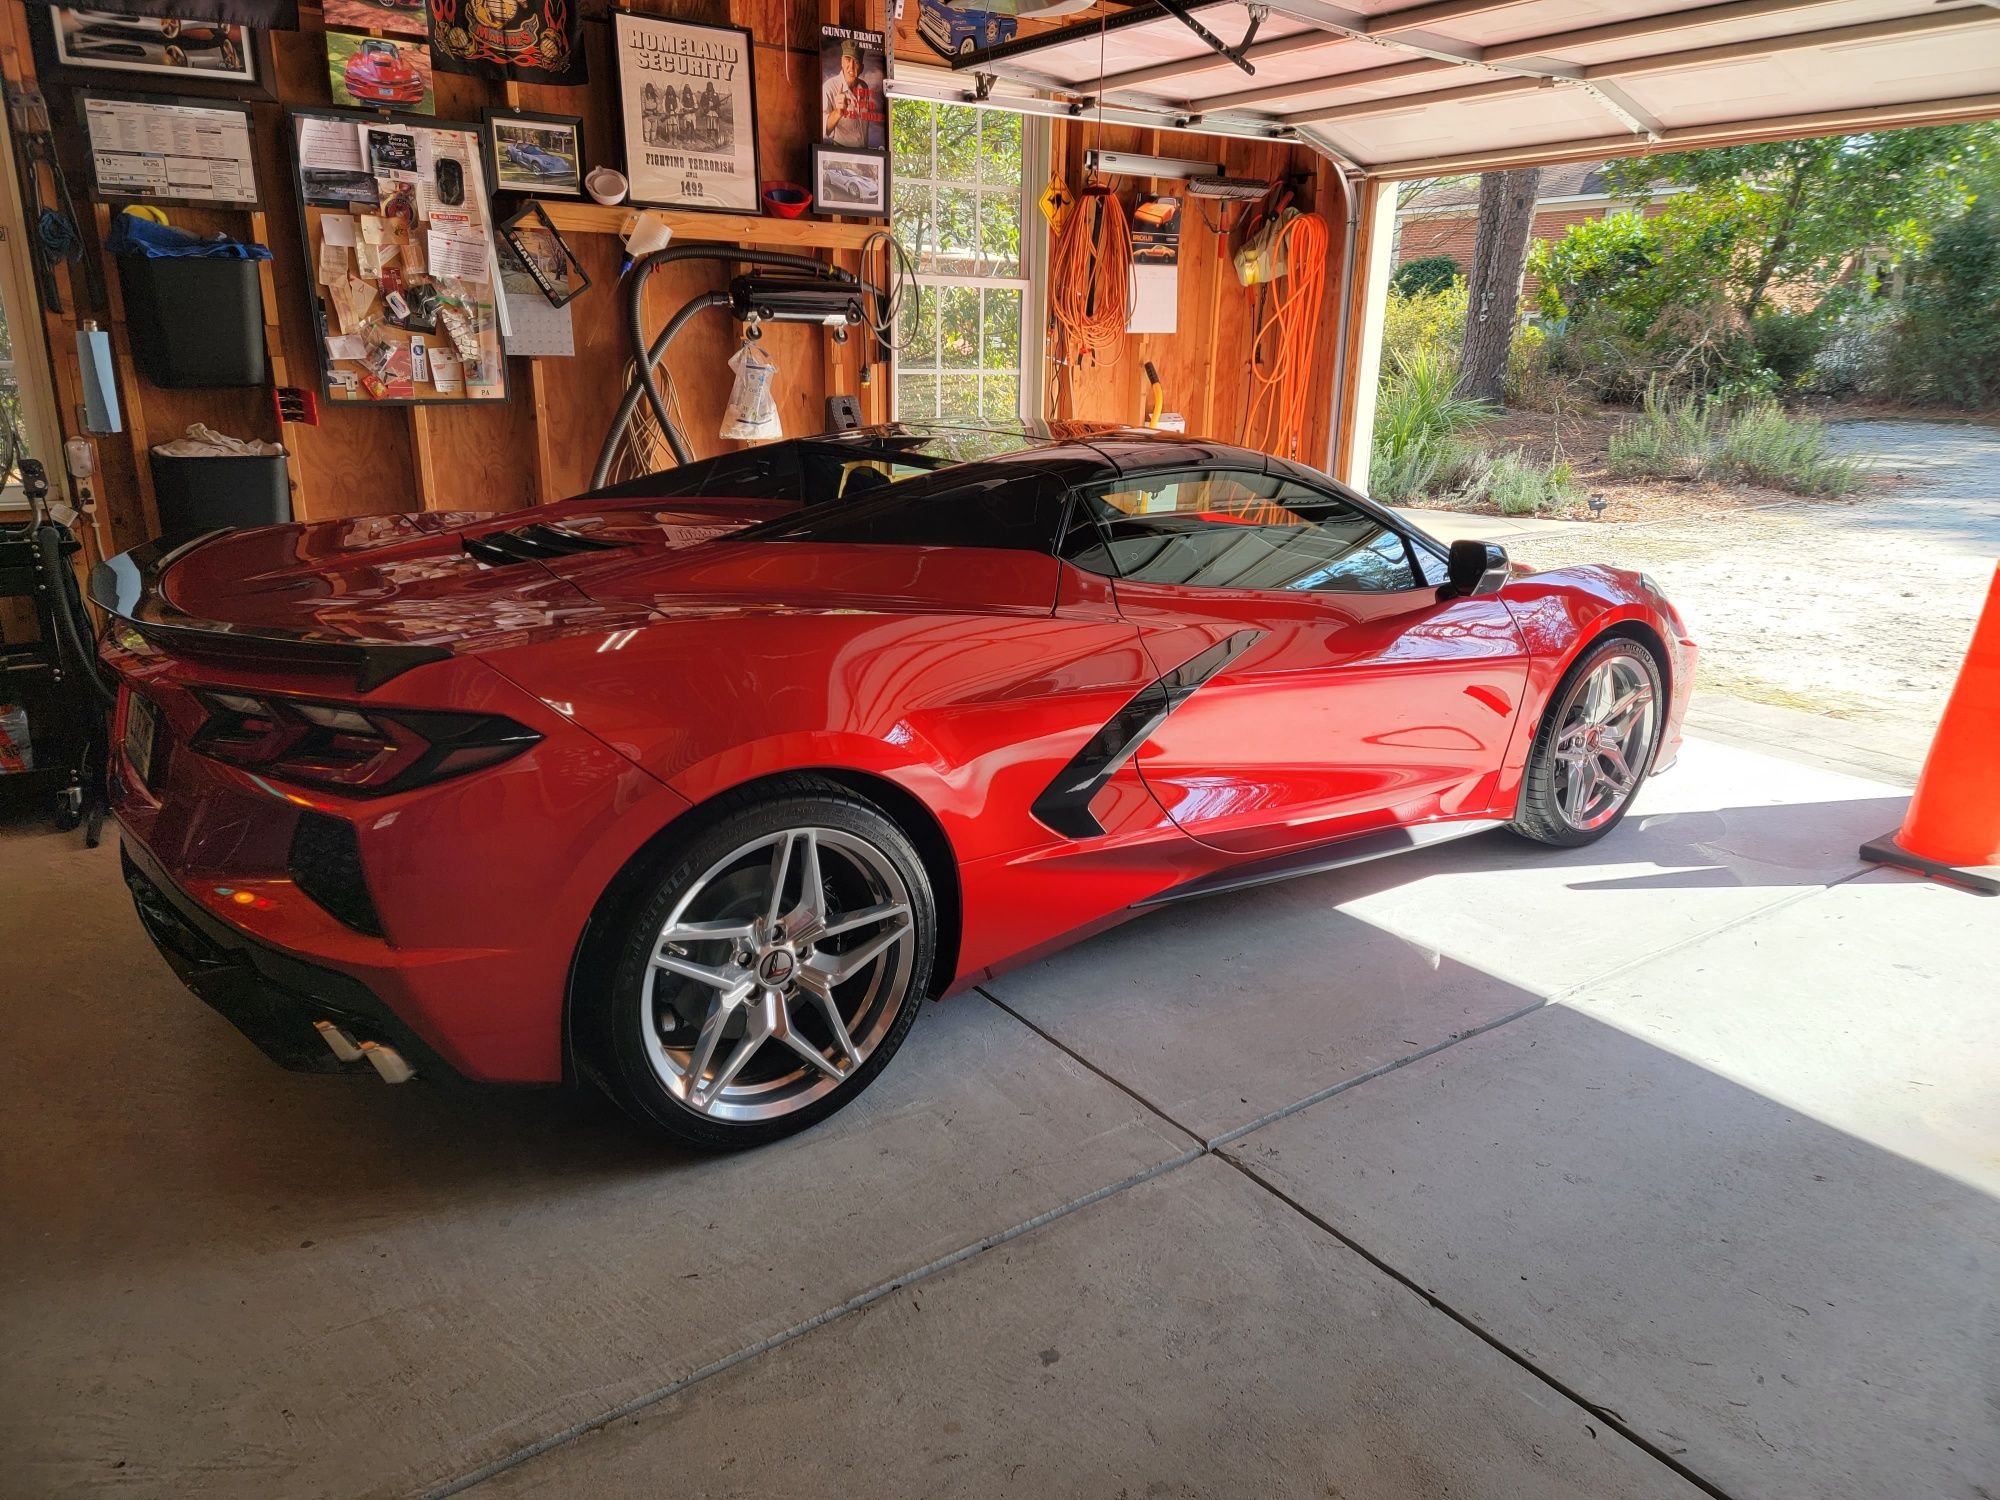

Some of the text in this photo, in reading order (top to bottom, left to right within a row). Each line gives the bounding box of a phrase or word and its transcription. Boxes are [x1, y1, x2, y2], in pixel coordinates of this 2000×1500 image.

[476, 24, 532, 45] MARINES
[628, 28, 738, 63] HOMELAND
[821, 25, 883, 44] GUNNY ERMEY
[638, 50, 734, 81] SECURITY
[645, 152, 735, 174] FIGHTING TERRORISM
[680, 180, 704, 197] 1492
[514, 241, 551, 291] MARINES
